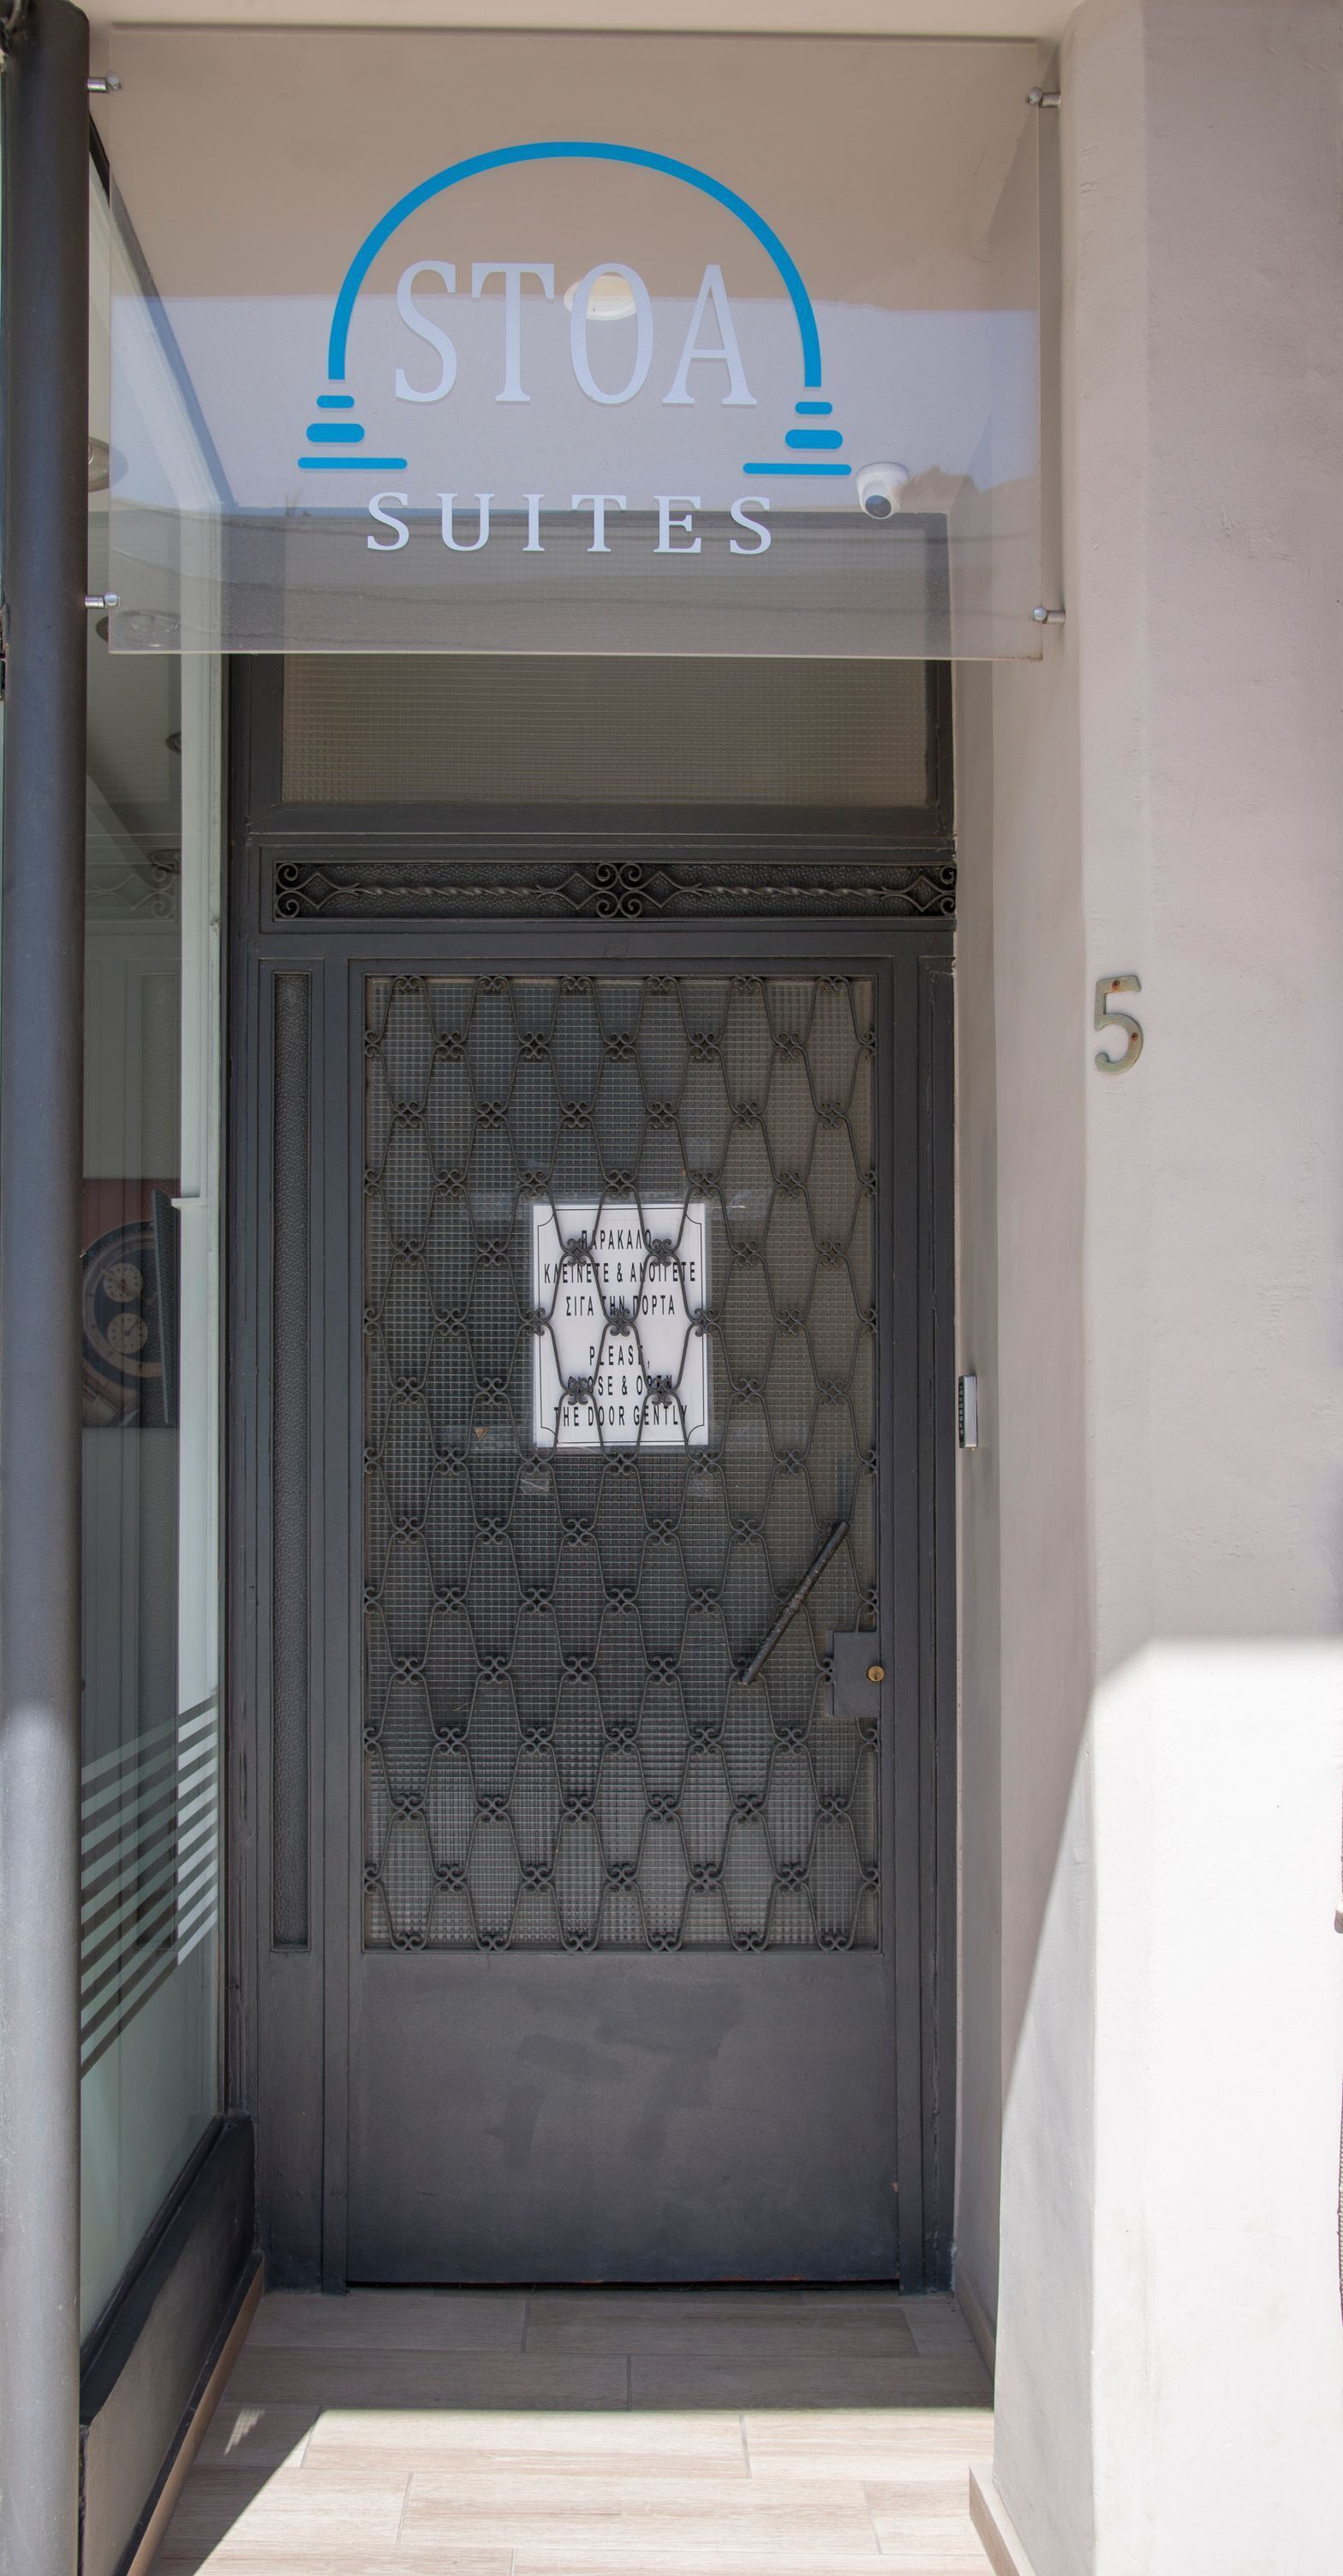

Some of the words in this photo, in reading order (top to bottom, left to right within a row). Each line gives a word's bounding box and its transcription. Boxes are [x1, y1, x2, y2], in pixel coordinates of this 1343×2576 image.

[395, 260, 757, 405] STOA
[367, 492, 772, 554] SUITES
[1094, 975, 1144, 1076] 5
[617, 1262, 624, 1283] &
[566, 1296, 594, 1316] ΣΙΓΑ
[633, 1294, 675, 1315] ΠΟΡΤΑ
[622, 1375, 628, 1396] &
[554, 1406, 579, 1427] THE
[588, 1405, 625, 1426] DOOR
[634, 1404, 687, 1426] GENTLY
